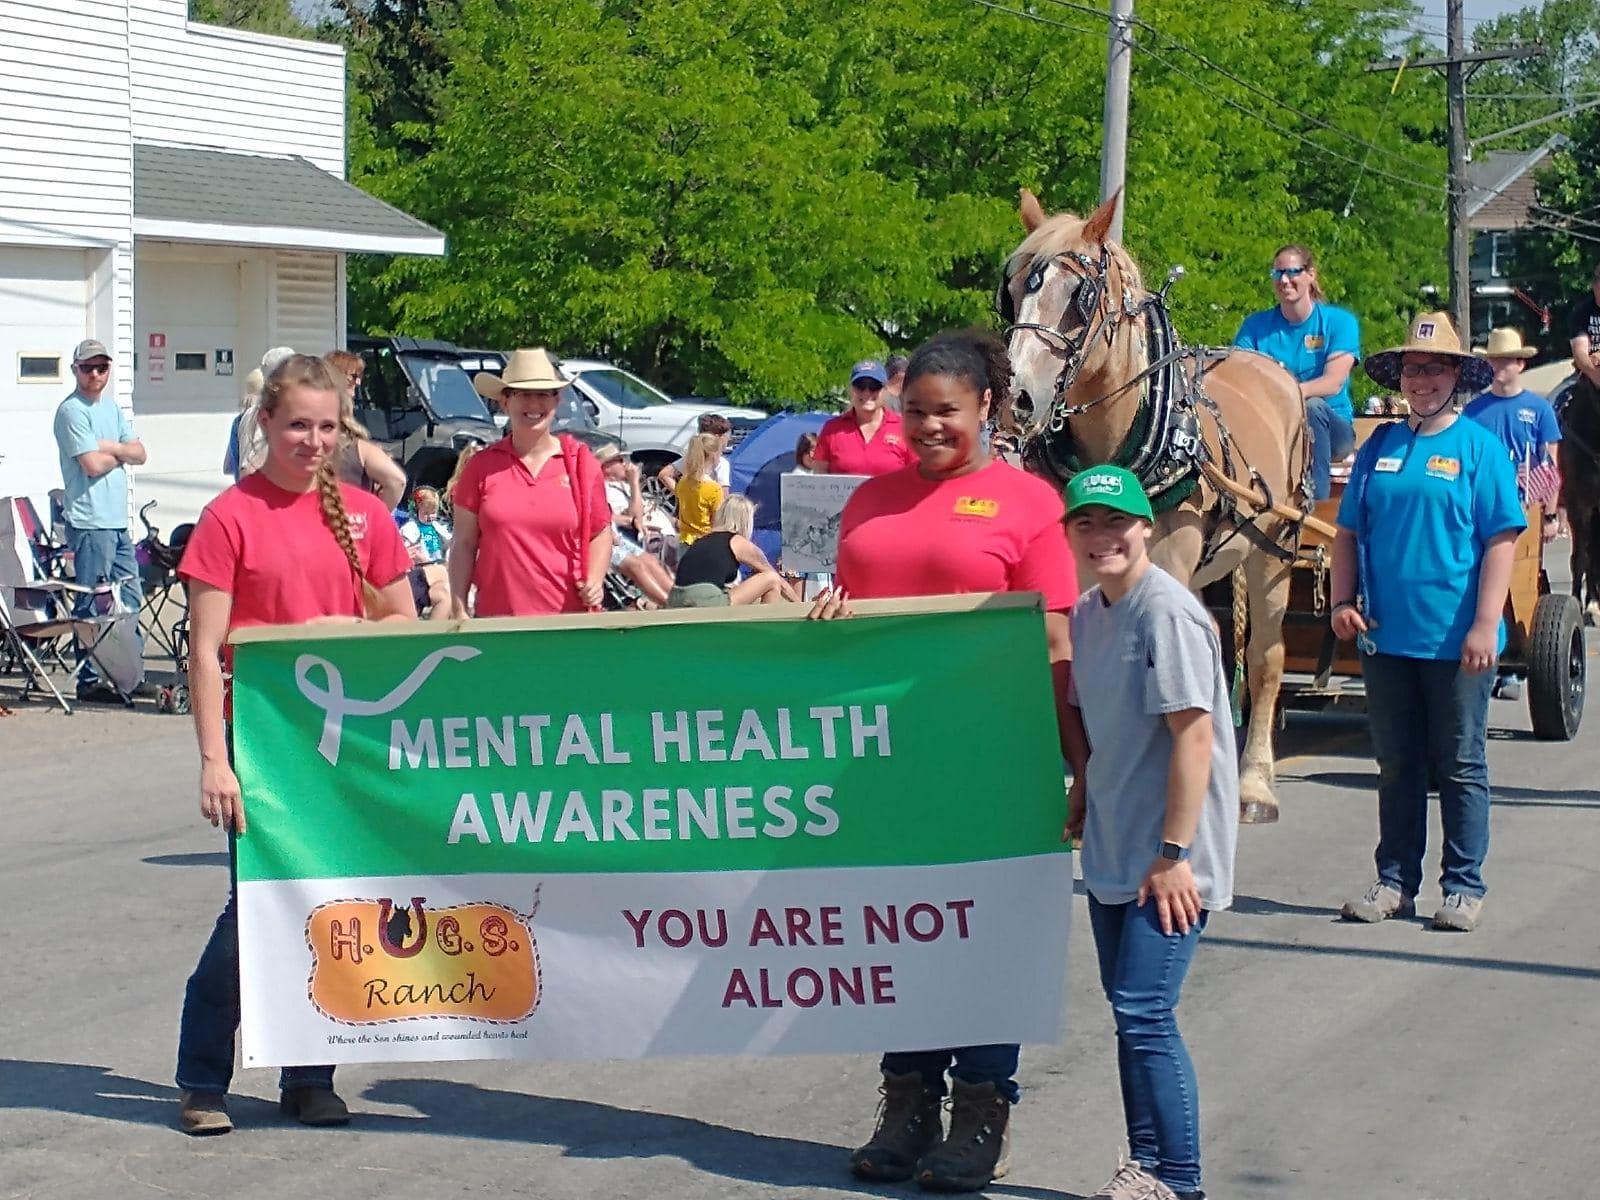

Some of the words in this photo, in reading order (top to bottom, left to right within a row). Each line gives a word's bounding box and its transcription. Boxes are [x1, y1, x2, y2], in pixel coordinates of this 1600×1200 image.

[388, 712, 631, 770] MENTAL
[650, 704, 892, 764] HEALTH
[447, 784, 841, 845] AWARENESS
[621, 907, 730, 949] YOU
[748, 905, 846, 947] ARE
[863, 899, 976, 946] NOT
[363, 971, 496, 1009] Ranch
[721, 964, 897, 1009] ALONE
[327, 1034, 356, 1045] Where
[357, 1033, 373, 1044] the
[391, 1032, 419, 1044] shines
[421, 1031, 440, 1042] and
[441, 1030, 482, 1041] wounded
[483, 1029, 509, 1040] hearts
[510, 1029, 528, 1040] heal
